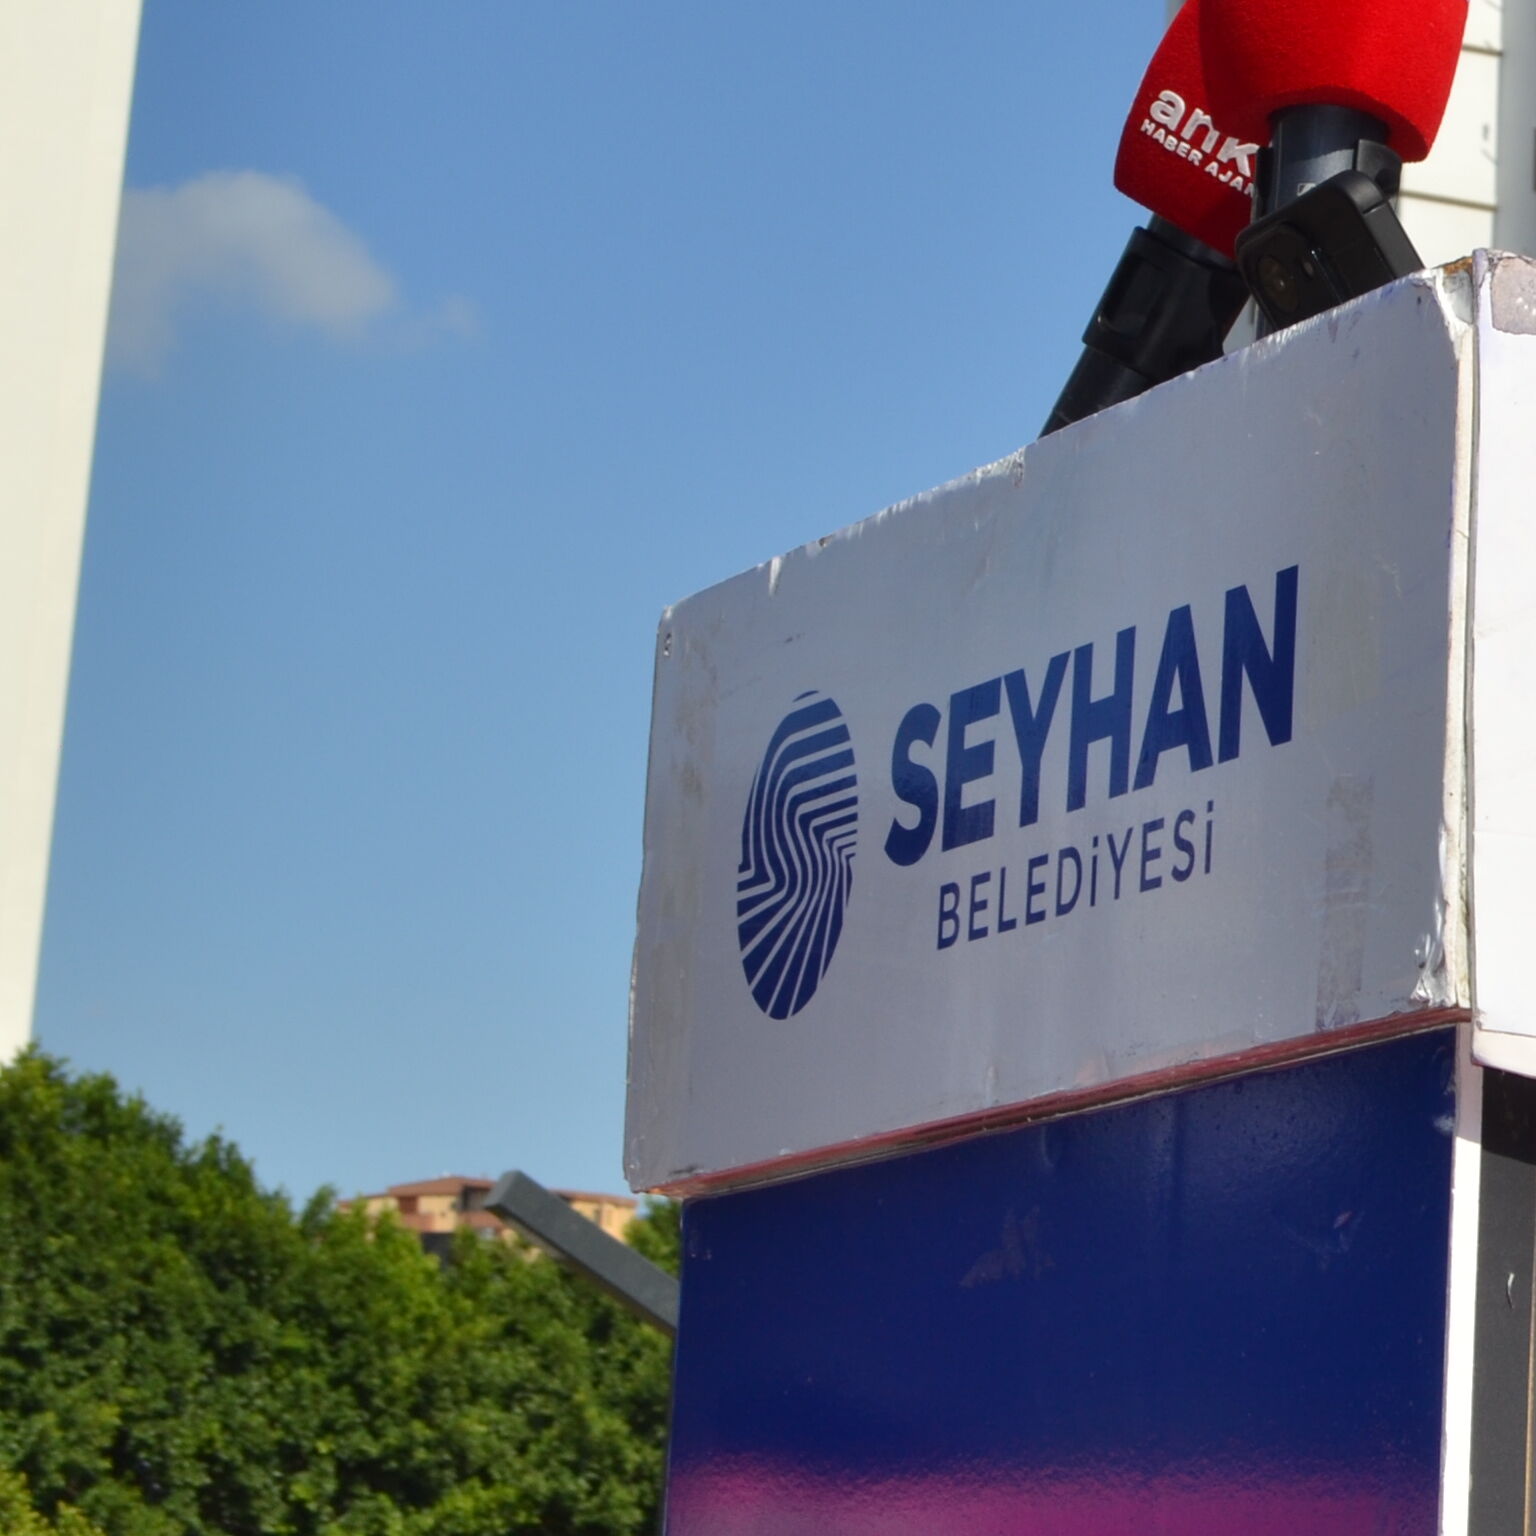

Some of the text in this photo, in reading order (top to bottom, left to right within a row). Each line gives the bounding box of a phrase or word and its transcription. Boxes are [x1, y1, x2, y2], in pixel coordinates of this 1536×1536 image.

[1140, 118, 1256, 198] HABER AJAN
[1149, 89, 1260, 178] ank
[883, 563, 1299, 867] SEYHAN
